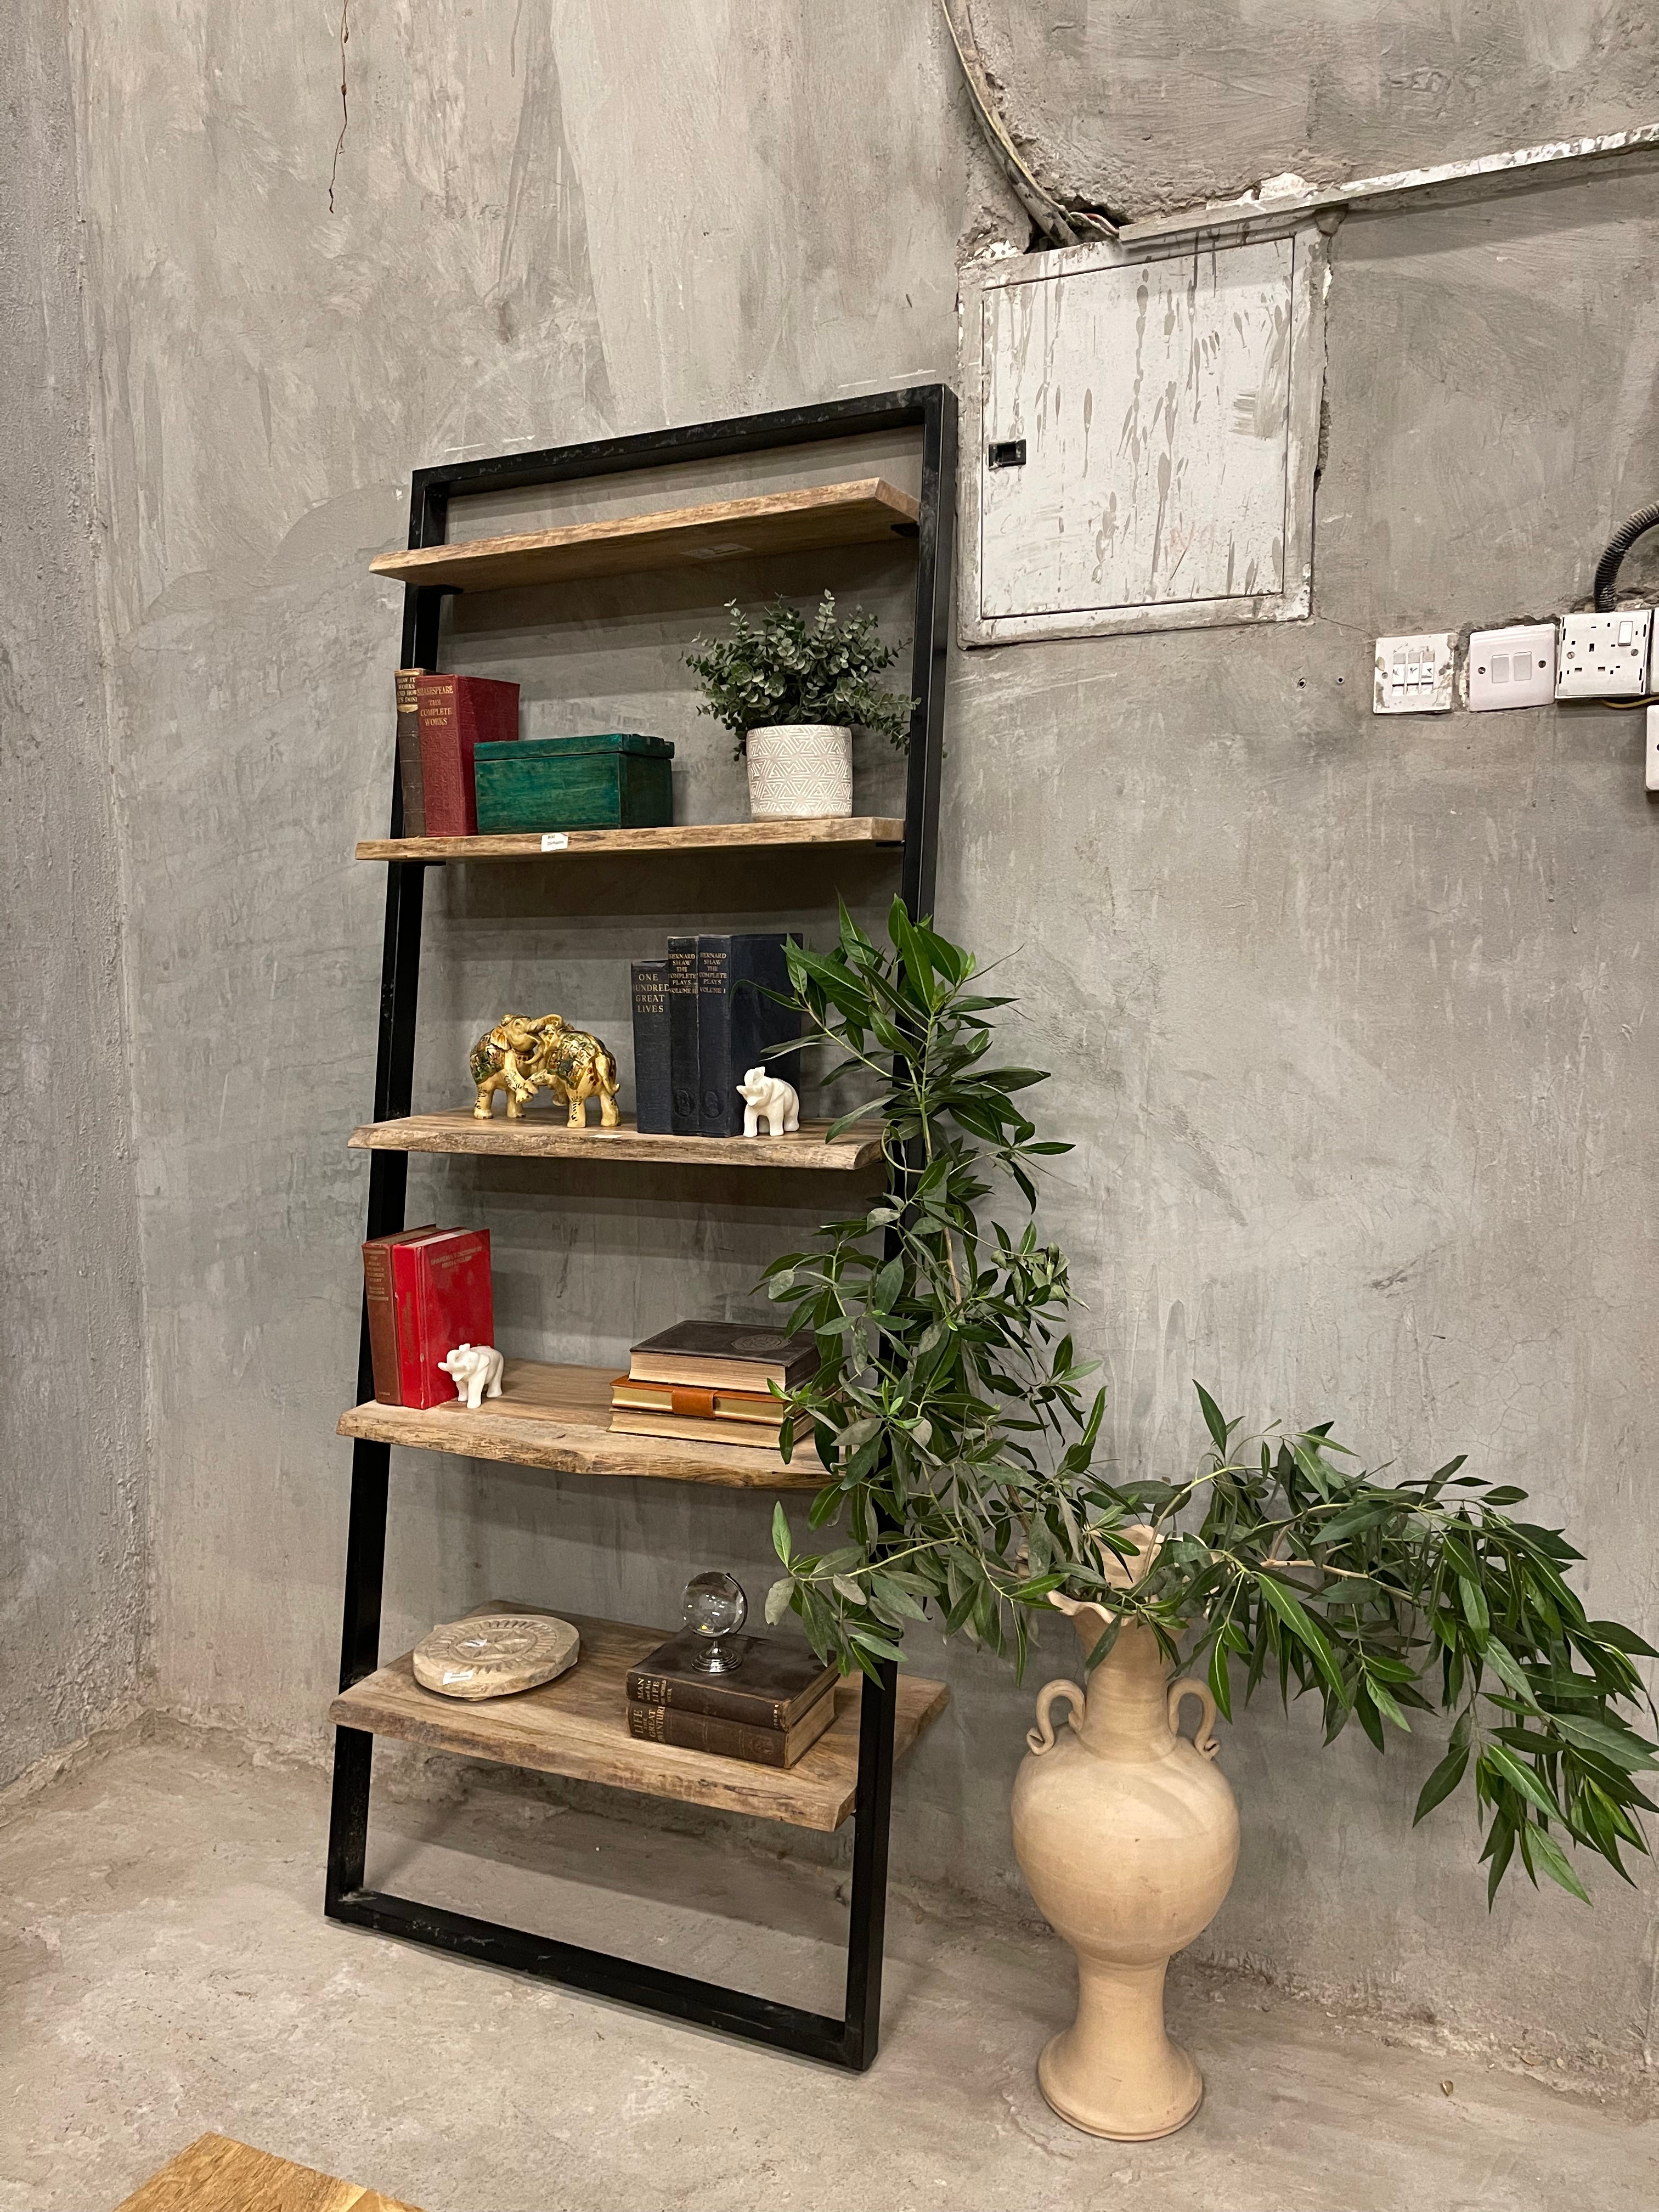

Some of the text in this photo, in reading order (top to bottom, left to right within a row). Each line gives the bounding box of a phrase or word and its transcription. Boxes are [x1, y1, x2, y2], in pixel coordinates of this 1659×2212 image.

[417, 685, 453, 696] SHAKESPEARE
[421, 708, 452, 716] COMPLETE
[425, 718, 448, 726] WORKS
[634, 1709, 644, 1734] LIFE
